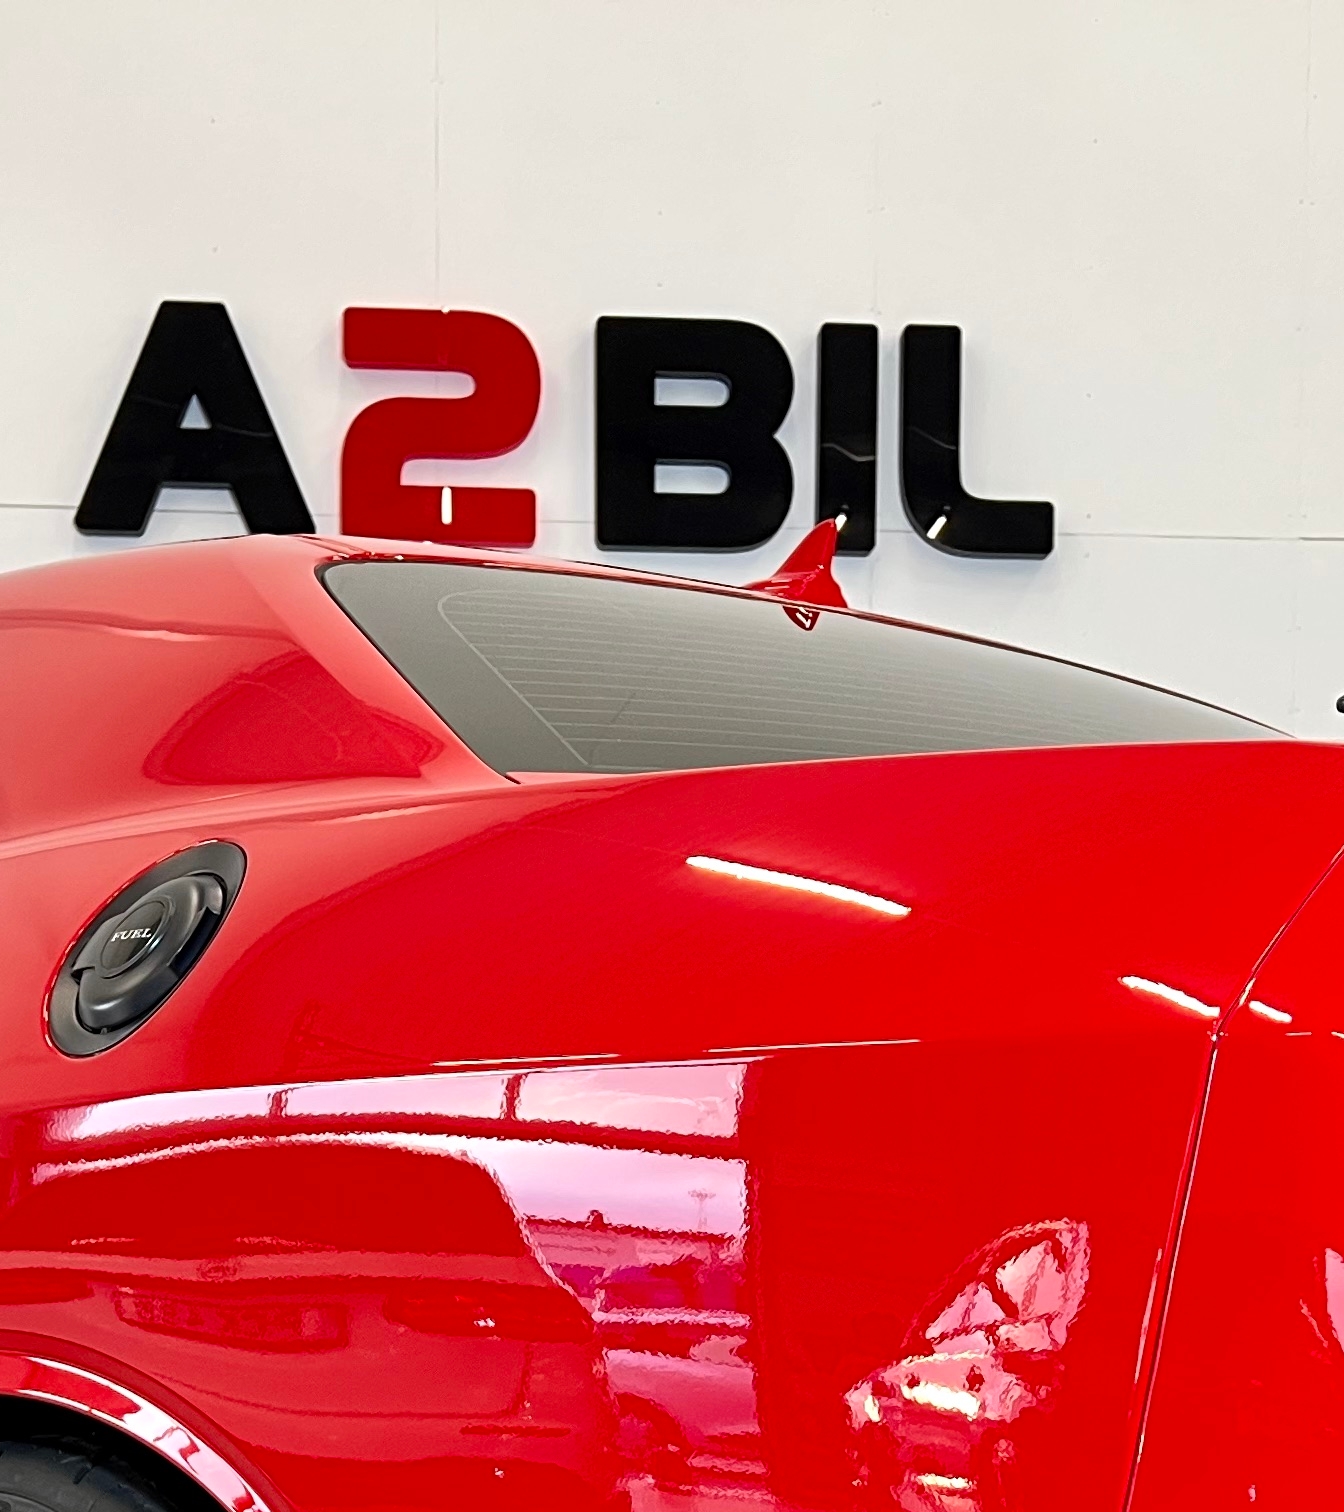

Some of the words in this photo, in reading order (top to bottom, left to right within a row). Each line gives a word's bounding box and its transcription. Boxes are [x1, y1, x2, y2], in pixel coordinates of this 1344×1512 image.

[74, 300, 541, 549] A2
[595, 315, 1054, 558] BIL
[111, 928, 153, 942] FUEL
